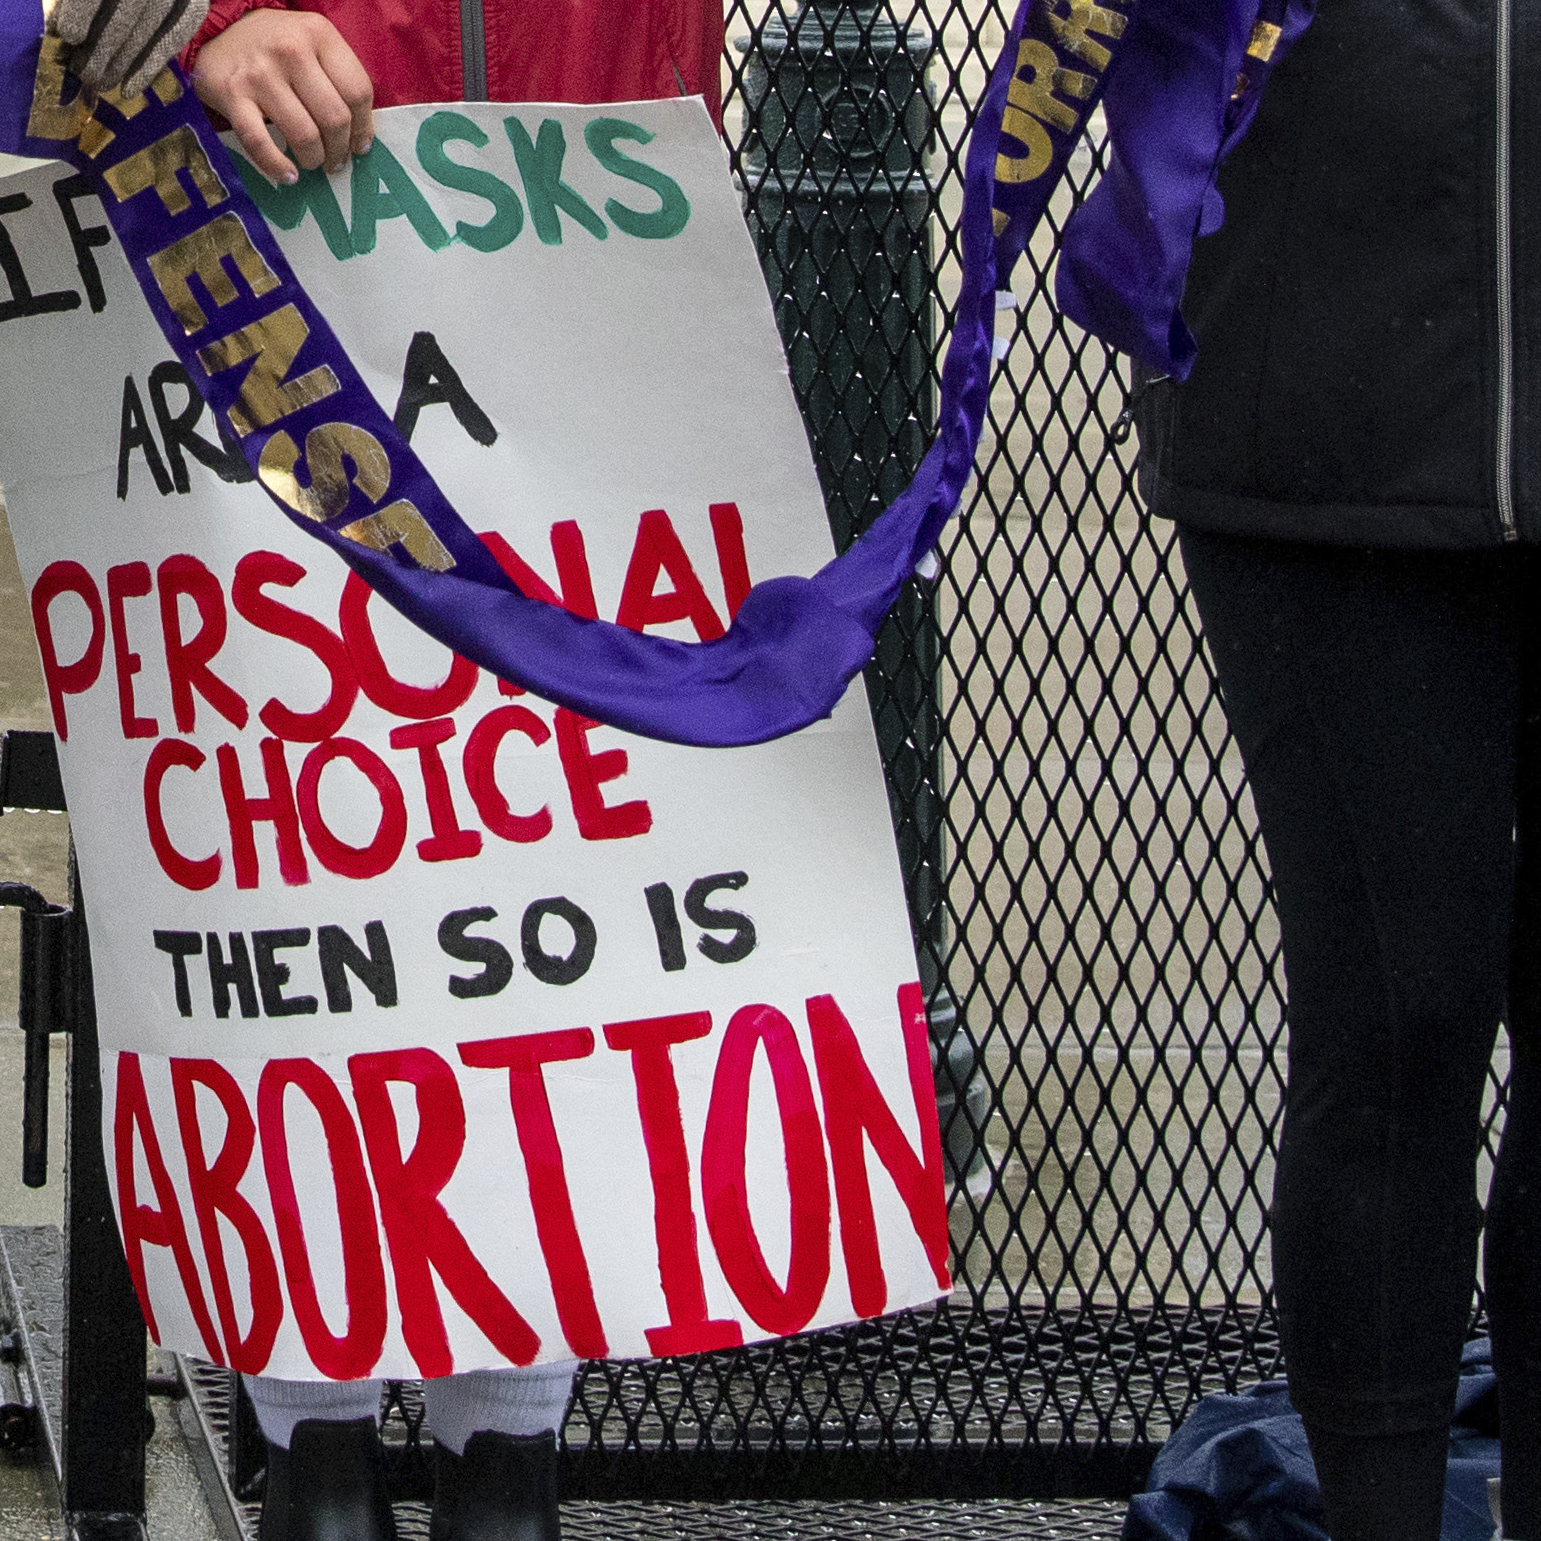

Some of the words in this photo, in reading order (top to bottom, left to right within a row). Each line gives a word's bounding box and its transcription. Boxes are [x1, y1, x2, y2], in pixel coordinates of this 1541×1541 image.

[225, 109, 692, 260] MASKS
[116, 360, 259, 501] AR
[394, 331, 498, 447] A
[143, 704, 653, 891] CHOICE
[153, 918, 399, 1019] THEN
[436, 896, 598, 999] SO
[644, 870, 759, 972] IS
[112, 980, 953, 1380] ABORTION
